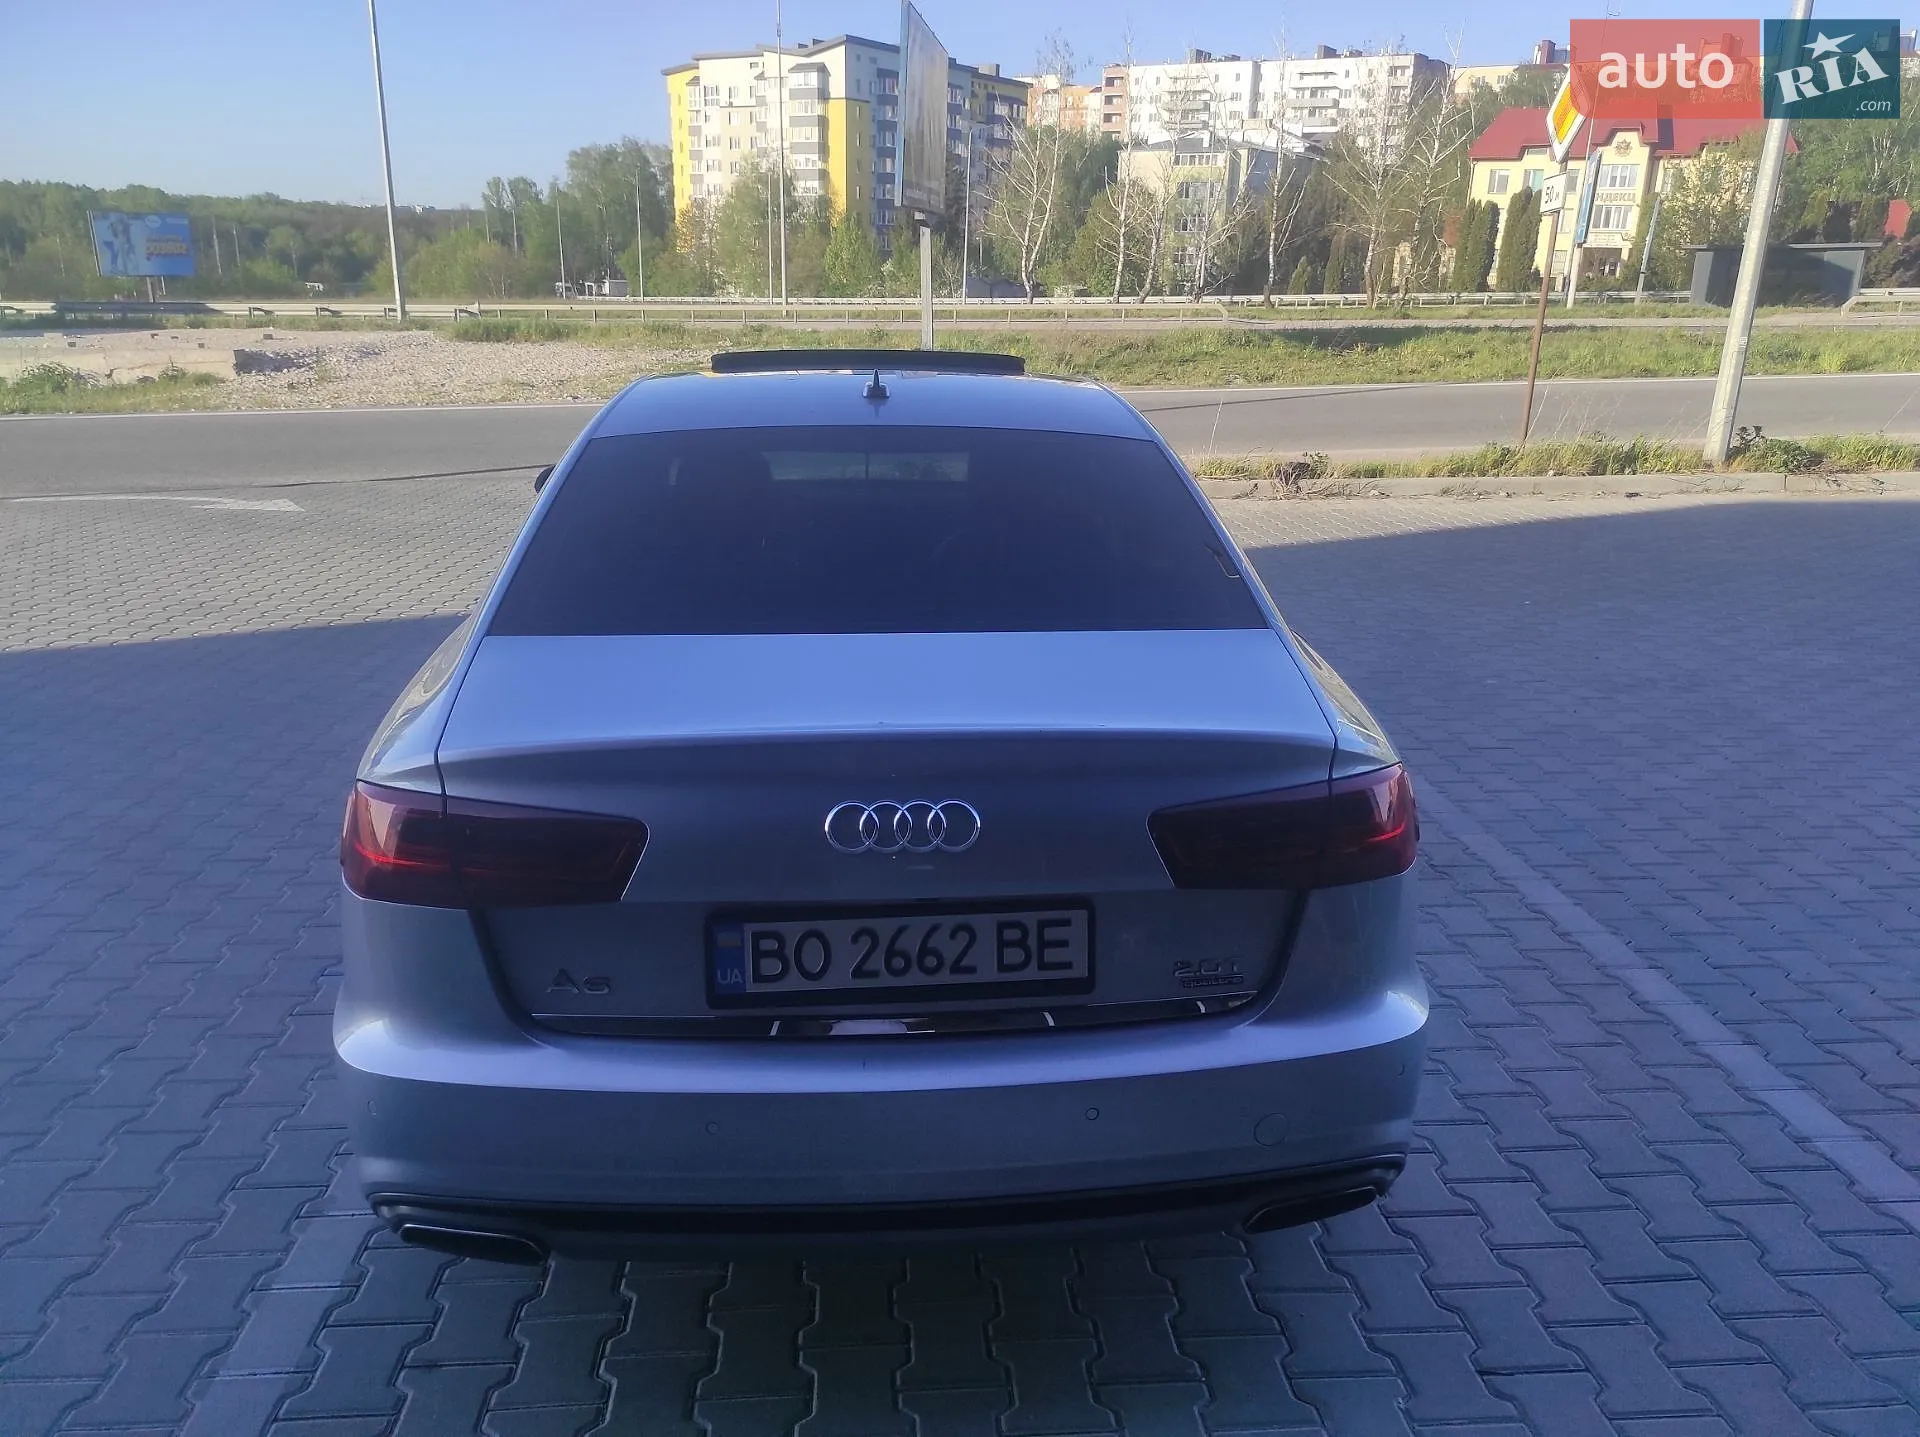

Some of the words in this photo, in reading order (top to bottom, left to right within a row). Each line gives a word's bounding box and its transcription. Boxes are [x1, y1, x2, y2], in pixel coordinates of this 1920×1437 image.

[1545, 185, 1554, 204] 50
[750, 928, 832, 984] BO
[849, 920, 978, 979] 2662
[995, 917, 1074, 974] BE
[546, 967, 612, 995] A6
[716, 966, 743, 986] UA
